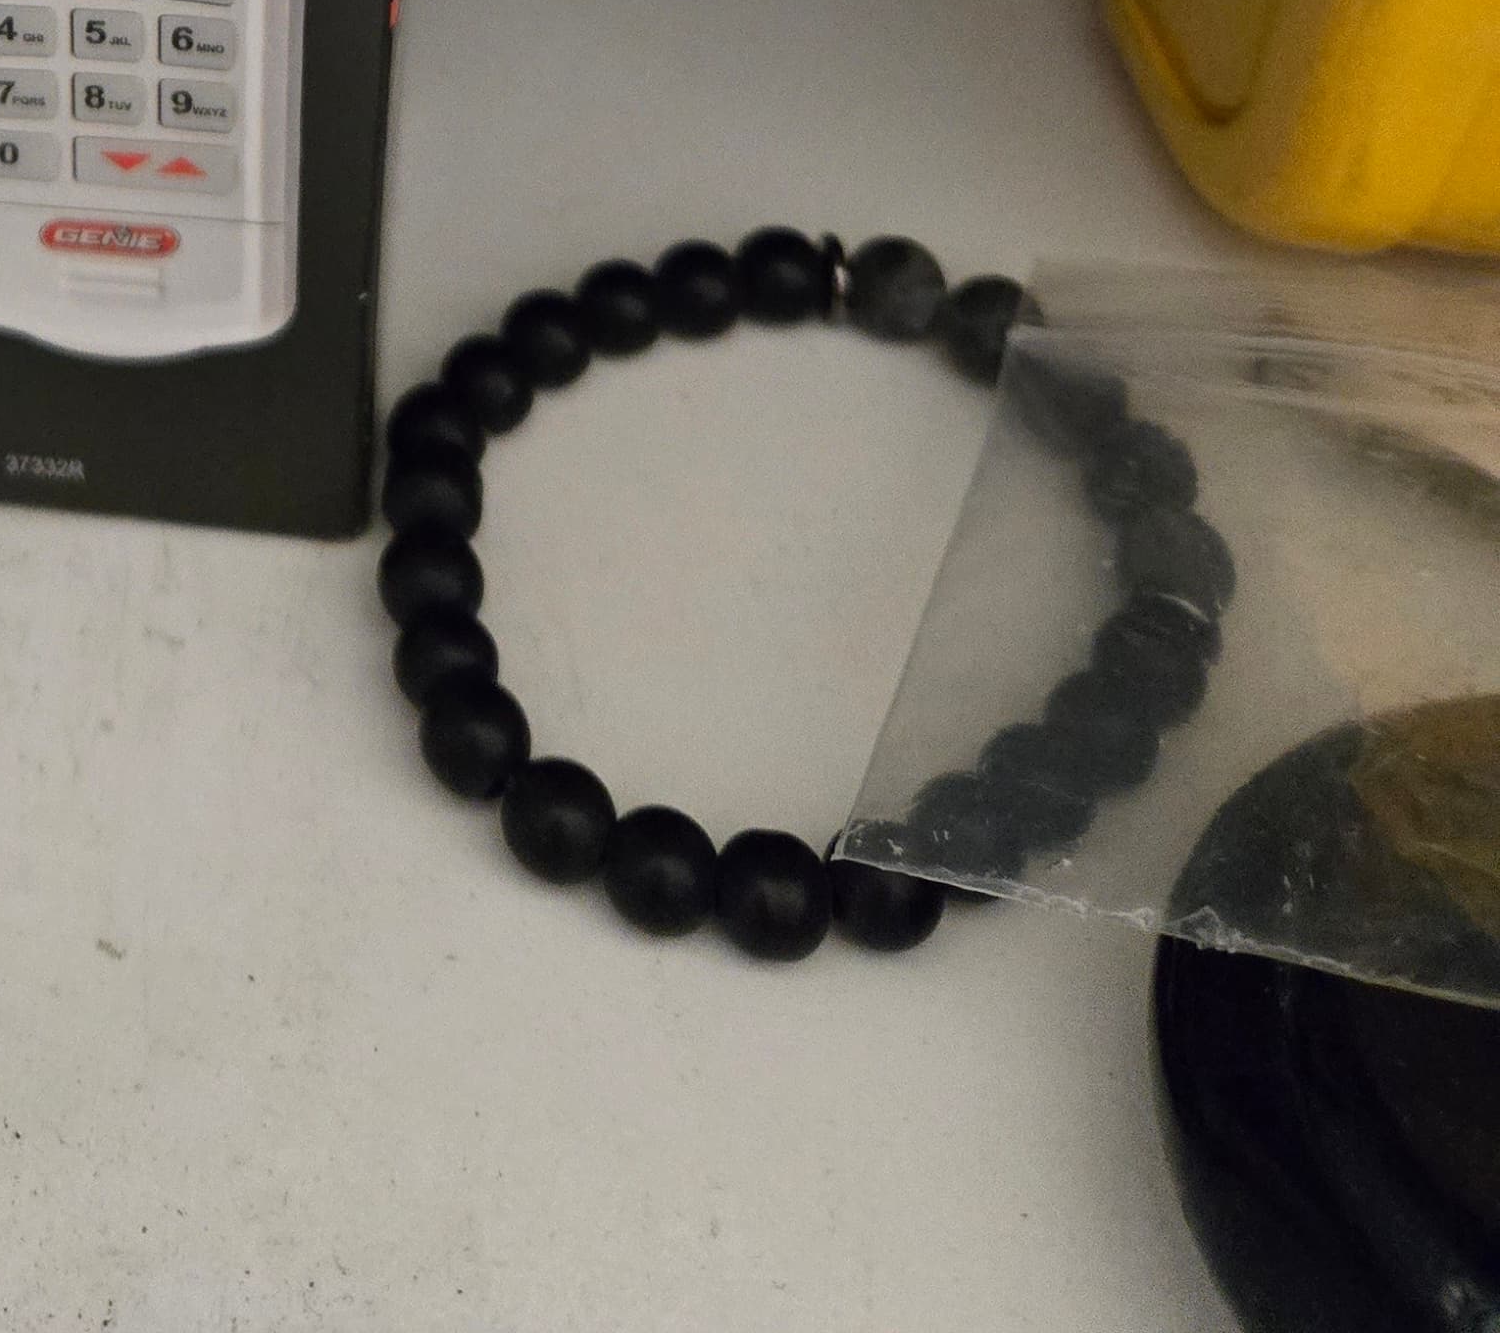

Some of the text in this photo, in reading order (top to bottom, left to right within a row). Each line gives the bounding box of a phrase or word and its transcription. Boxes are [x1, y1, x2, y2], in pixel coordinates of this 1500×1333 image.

[85, 20, 107, 46] 5
[171, 26, 225, 55] 6 MNO
[84, 85, 133, 112] 8 TUV
[170, 90, 228, 119] 9 WXYZ
[53, 228, 165, 251] GENIE
